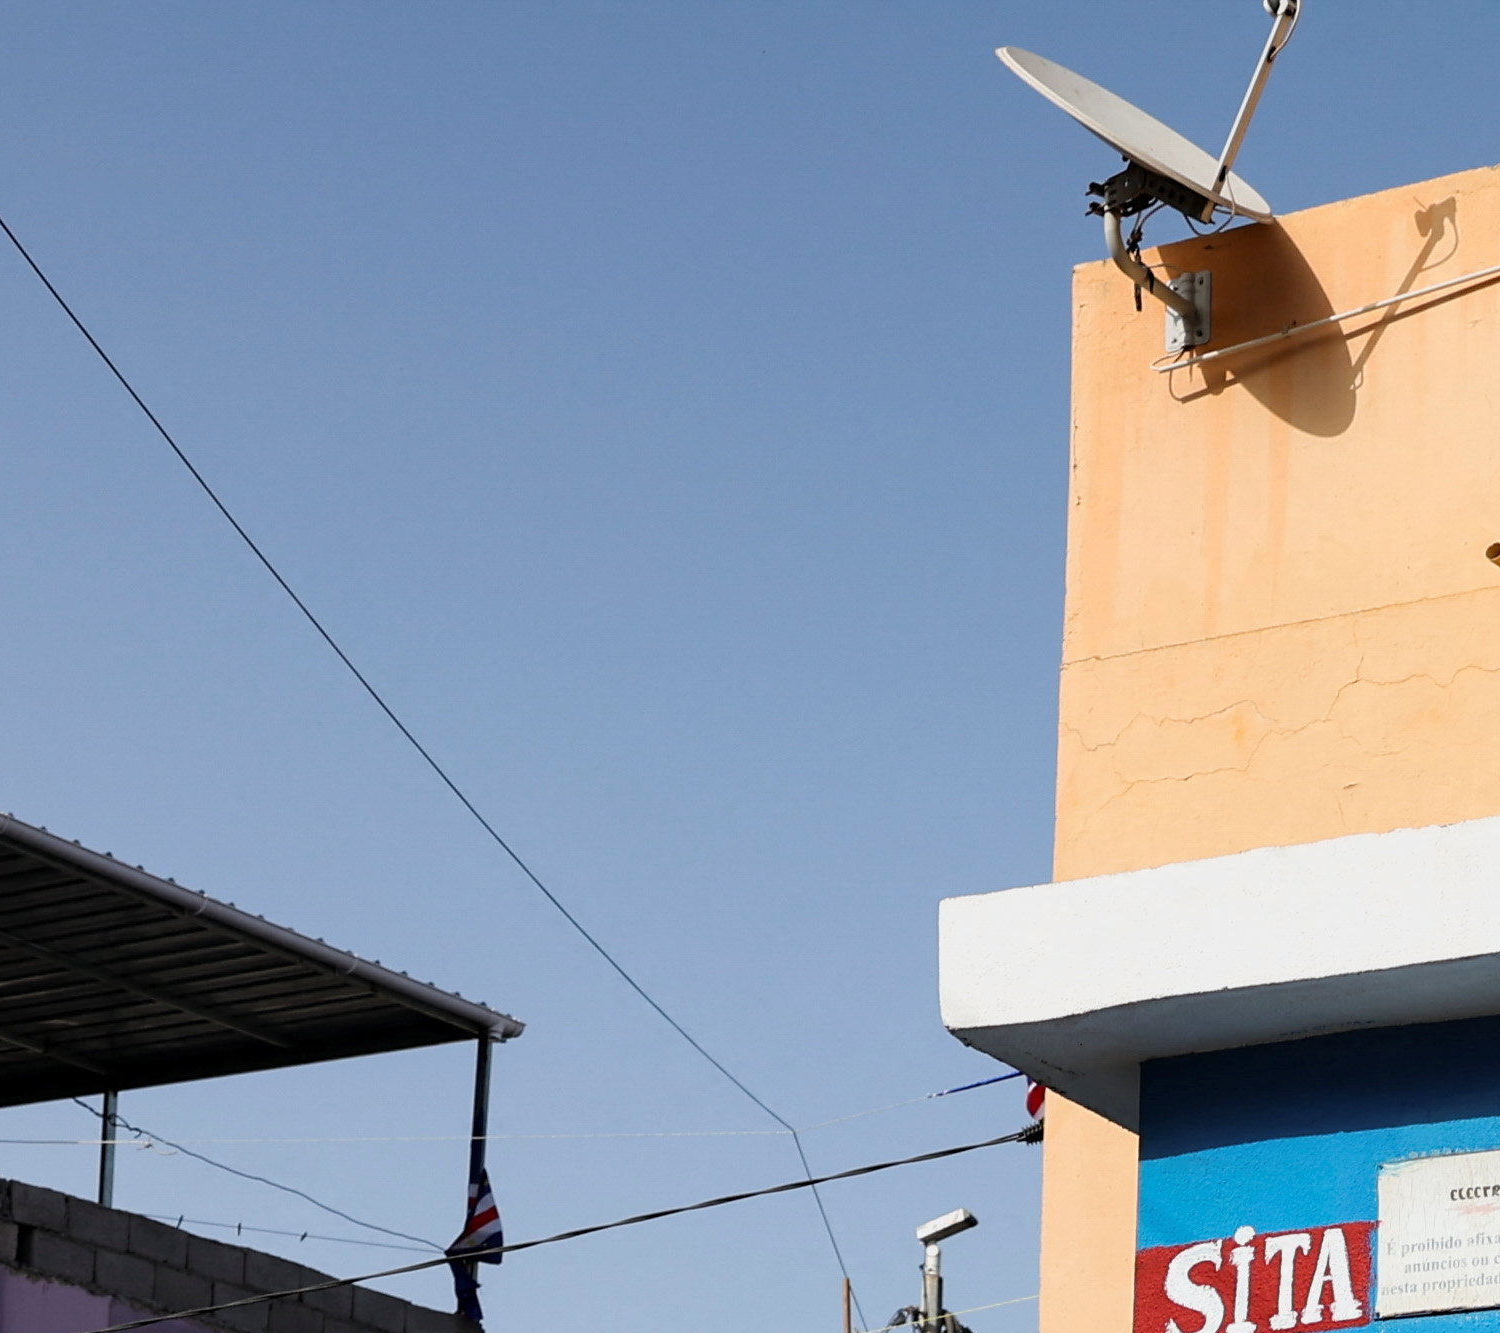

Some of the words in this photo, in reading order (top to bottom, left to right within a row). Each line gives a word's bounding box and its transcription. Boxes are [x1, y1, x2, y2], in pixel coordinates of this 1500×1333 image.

[1401, 1236, 1463, 1258] proibido
[1404, 1255, 1468, 1274] anúncios
[1471, 1255, 1489, 1267] ou
[1381, 1279, 1418, 1296] nesta
